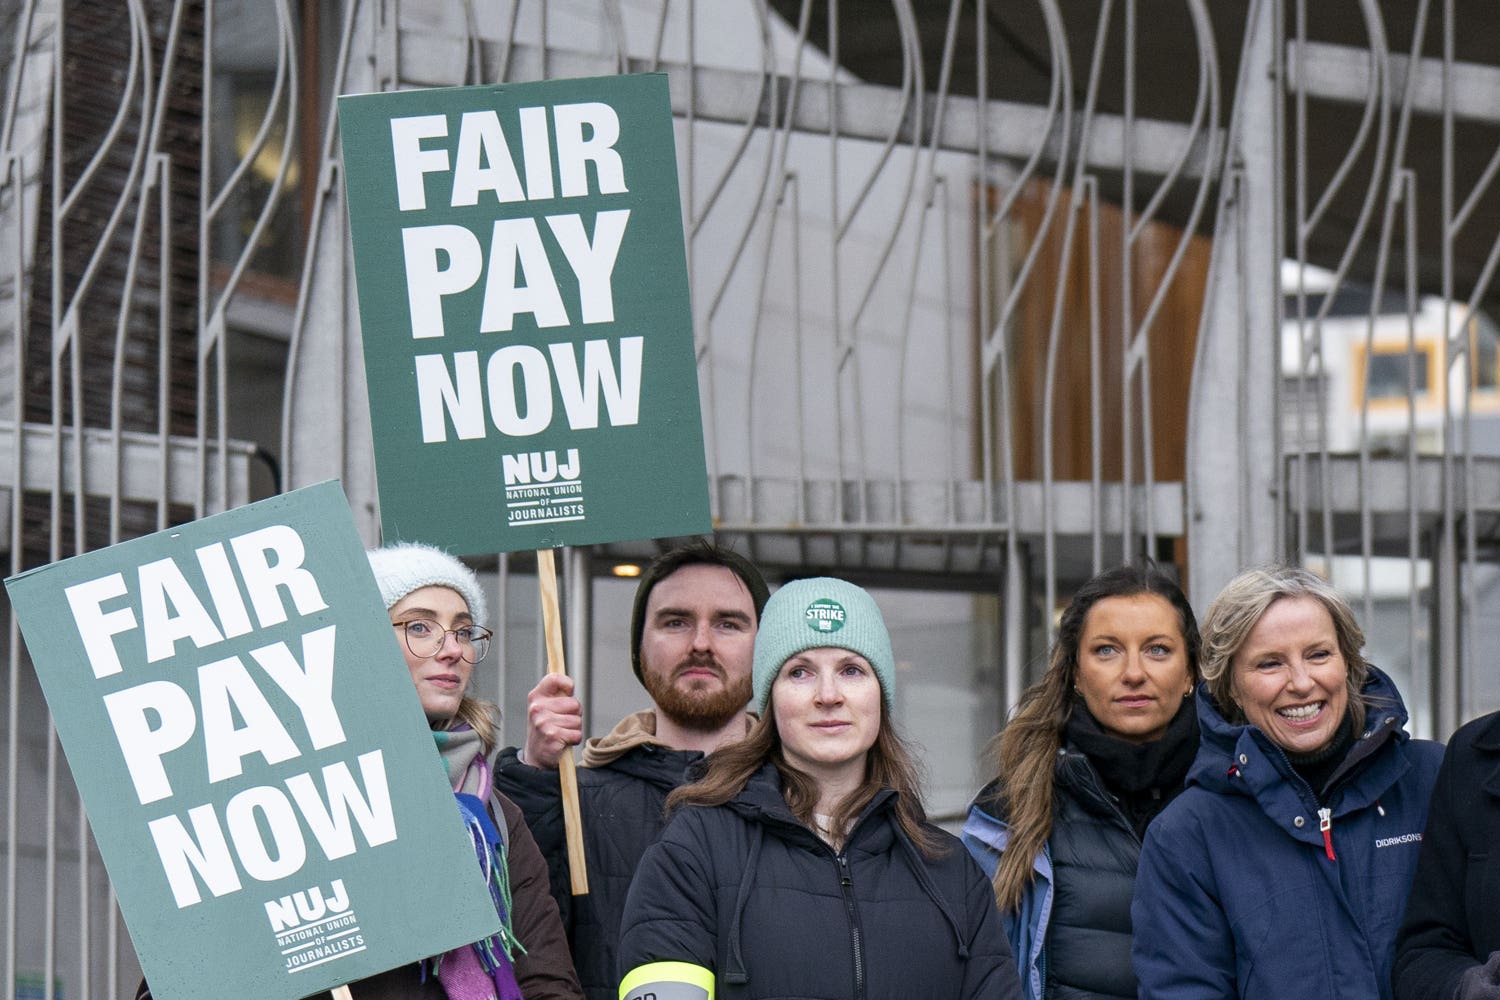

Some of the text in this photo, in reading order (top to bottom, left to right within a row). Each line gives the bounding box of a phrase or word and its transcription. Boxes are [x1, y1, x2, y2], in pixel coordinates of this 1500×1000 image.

[391, 103, 628, 210] FAIR
[402, 210, 630, 338] PAY
[416, 337, 643, 442] NOW
[502, 449, 580, 485] NUJ
[506, 485, 582, 499] NATIONAL UNION
[508, 505, 584, 520] JOURNALISTS
[65, 525, 329, 679] FAIR
[806, 609, 844, 621] STRIKE
[103, 625, 346, 805] PAY
[148, 750, 397, 908] NOW
[264, 879, 350, 932] NUJ
[277, 915, 356, 946] NATIONAL UNION
[286, 935, 364, 968] JOURNALISTS
[315, 936, 325, 946] OF
